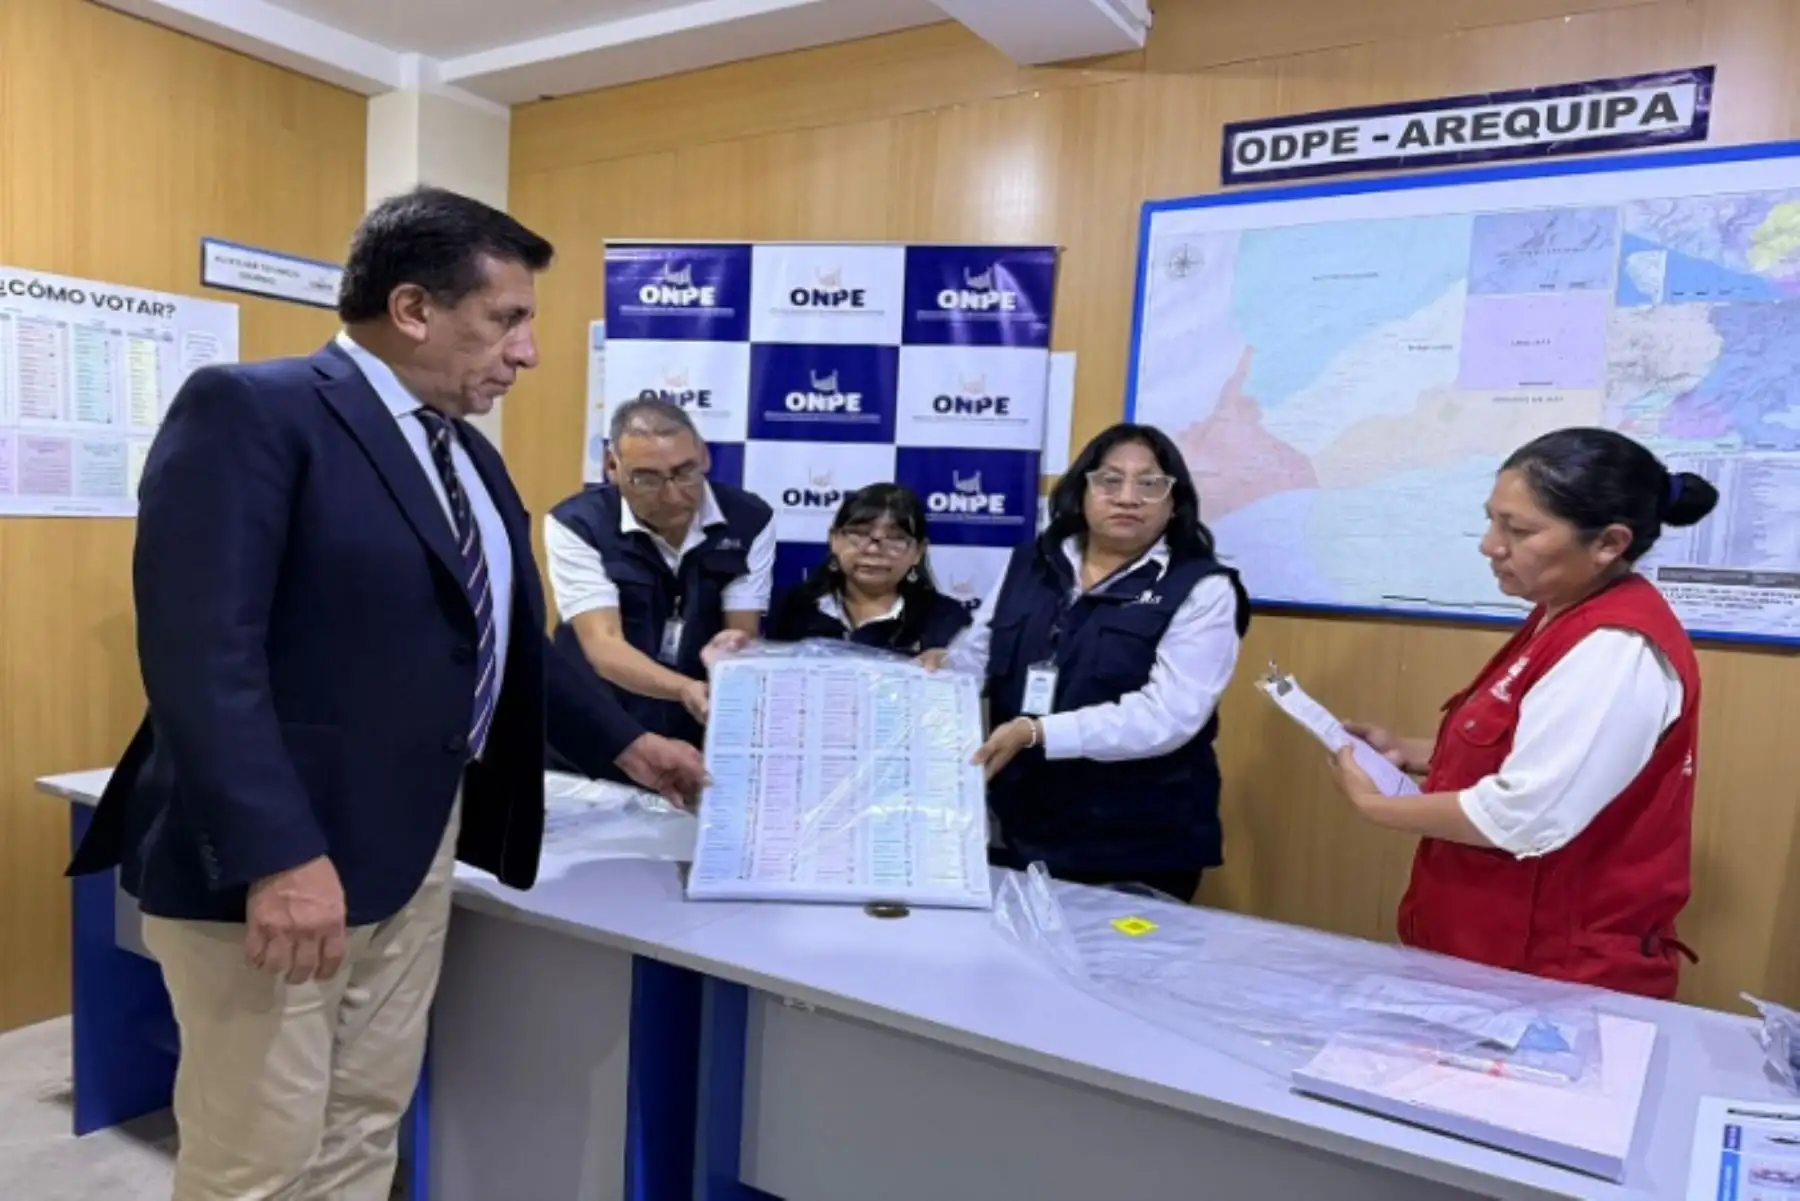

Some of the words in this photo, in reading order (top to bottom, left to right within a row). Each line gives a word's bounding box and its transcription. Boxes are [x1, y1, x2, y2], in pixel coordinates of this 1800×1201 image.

[1236, 126, 1360, 166] ODPE
[1396, 91, 1680, 149] AREQUIPA
[90, 293, 177, 319] VOTAR?
[638, 284, 717, 307] ONPE
[790, 287, 866, 308] ONPE
[936, 289, 1018, 311] ONPE
[784, 391, 862, 413] ONPE
[932, 394, 1011, 416] ONPE
[927, 491, 1007, 514] ONPE
